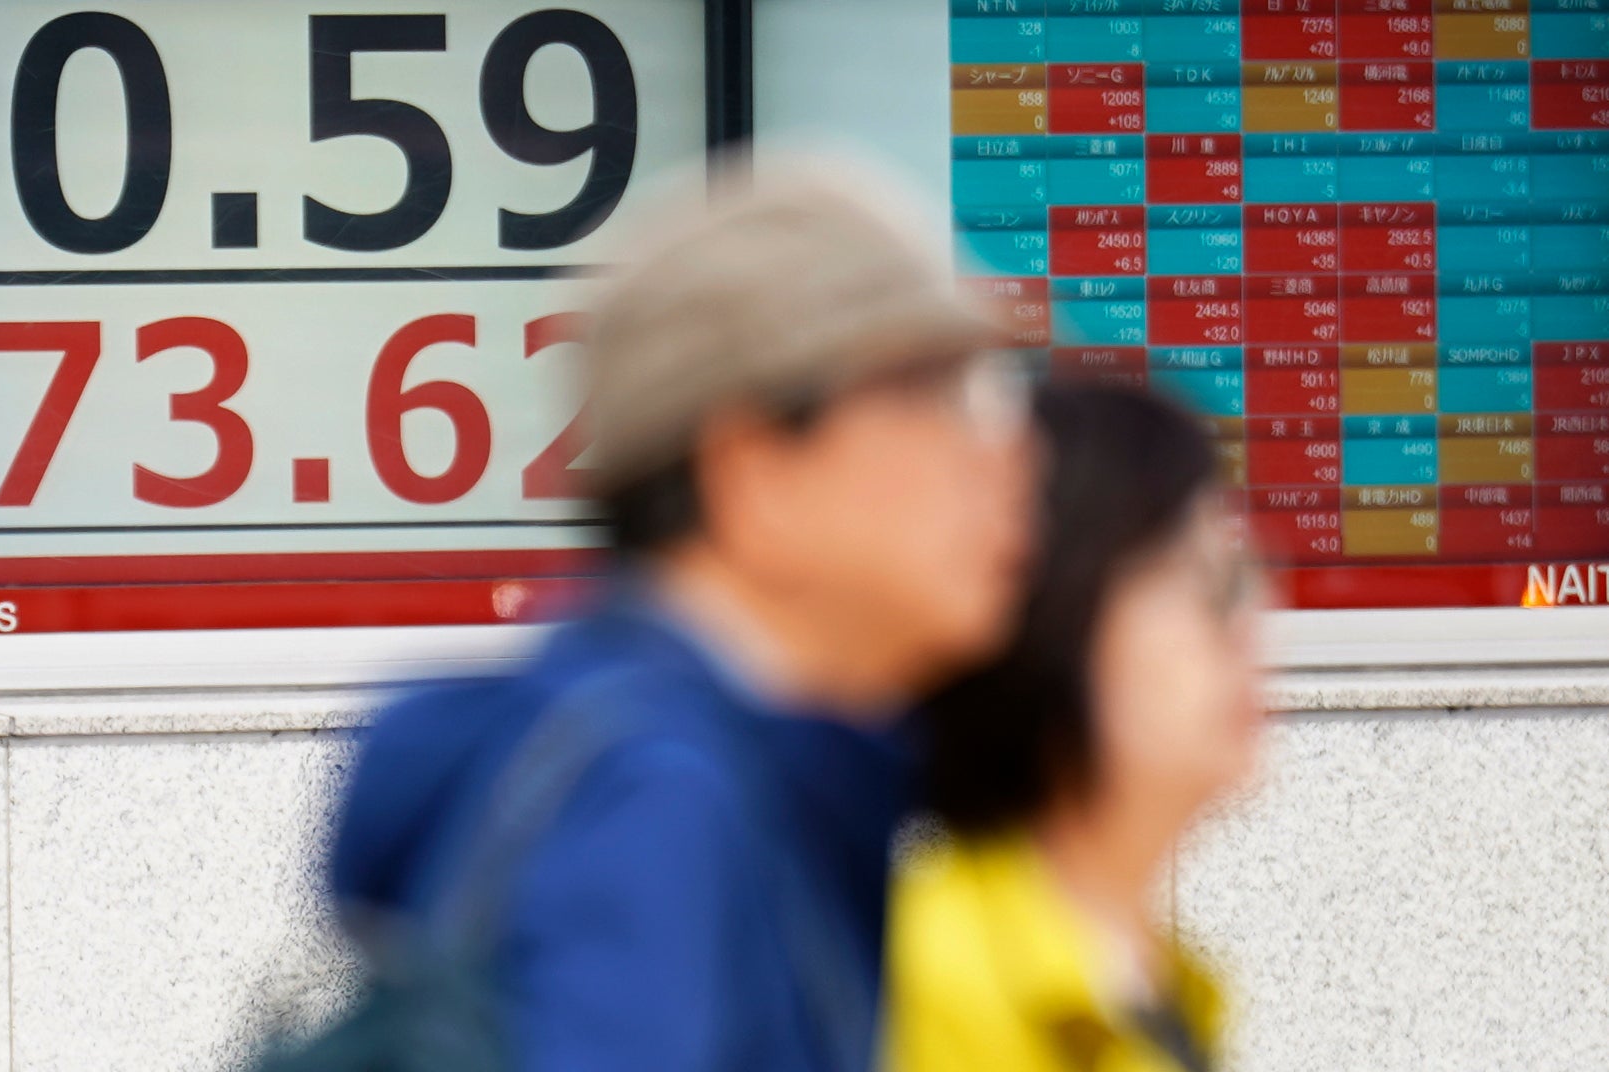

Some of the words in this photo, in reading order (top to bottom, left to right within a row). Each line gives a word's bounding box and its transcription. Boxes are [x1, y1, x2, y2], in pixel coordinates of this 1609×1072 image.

[1018, 22, 1042, 36] 328
[1109, 22, 1140, 35] 1003
[1301, 18, 1334, 33] 7375
[1309, 42, 1334, 56] +70
[1516, 41, 1527, 55] 0
[1067, 68, 1124, 84] ソニーG
[1173, 68, 1213, 83] TDK
[1018, 92, 1043, 107] 958
[1100, 91, 1141, 106] 12005
[1033, 115, 1044, 129] 0
[1108, 114, 1141, 129] +105
[1324, 113, 1335, 127] 0
[1413, 112, 1431, 126] +2
[1272, 137, 1309, 153] IHI
[1205, 162, 1238, 176] 2889
[1220, 186, 1239, 200] +9
[976, 212, 1021, 227] ニコン
[1167, 209, 1222, 225] スクリン
[1264, 207, 1320, 224] HOYA
[1013, 235, 1044, 250] 1279
[1387, 230, 1432, 245] 2932.5
[1496, 229, 1528, 244] 1014
[1113, 257, 1142, 271] +6.5
[1310, 255, 1336, 269] +35
[1403, 254, 1432, 267] +0.5
[1195, 302, 1240, 318] 2454.5
[1303, 302, 1336, 317] 5046
[1401, 300, 1432, 316] 1921
[1202, 326, 1240, 341] +32.0
[1415, 324, 1433, 338] +4
[1447, 347, 1520, 364] SOMPOHD
[1563, 346, 1600, 361] JPX
[1300, 373, 1336, 388] 501.1
[1307, 396, 1337, 411] +0.8
[1423, 395, 1434, 410] 0
[1303, 443, 1337, 458] 4900
[1312, 467, 1337, 482] +30
[1520, 463, 1530, 478] 0
[1295, 514, 1338, 530] 1515.0
[1498, 510, 1531, 526] 1437
[1309, 537, 1338, 552] +3.0
[1425, 536, 1436, 551] 0
[1505, 534, 1533, 549] +14
